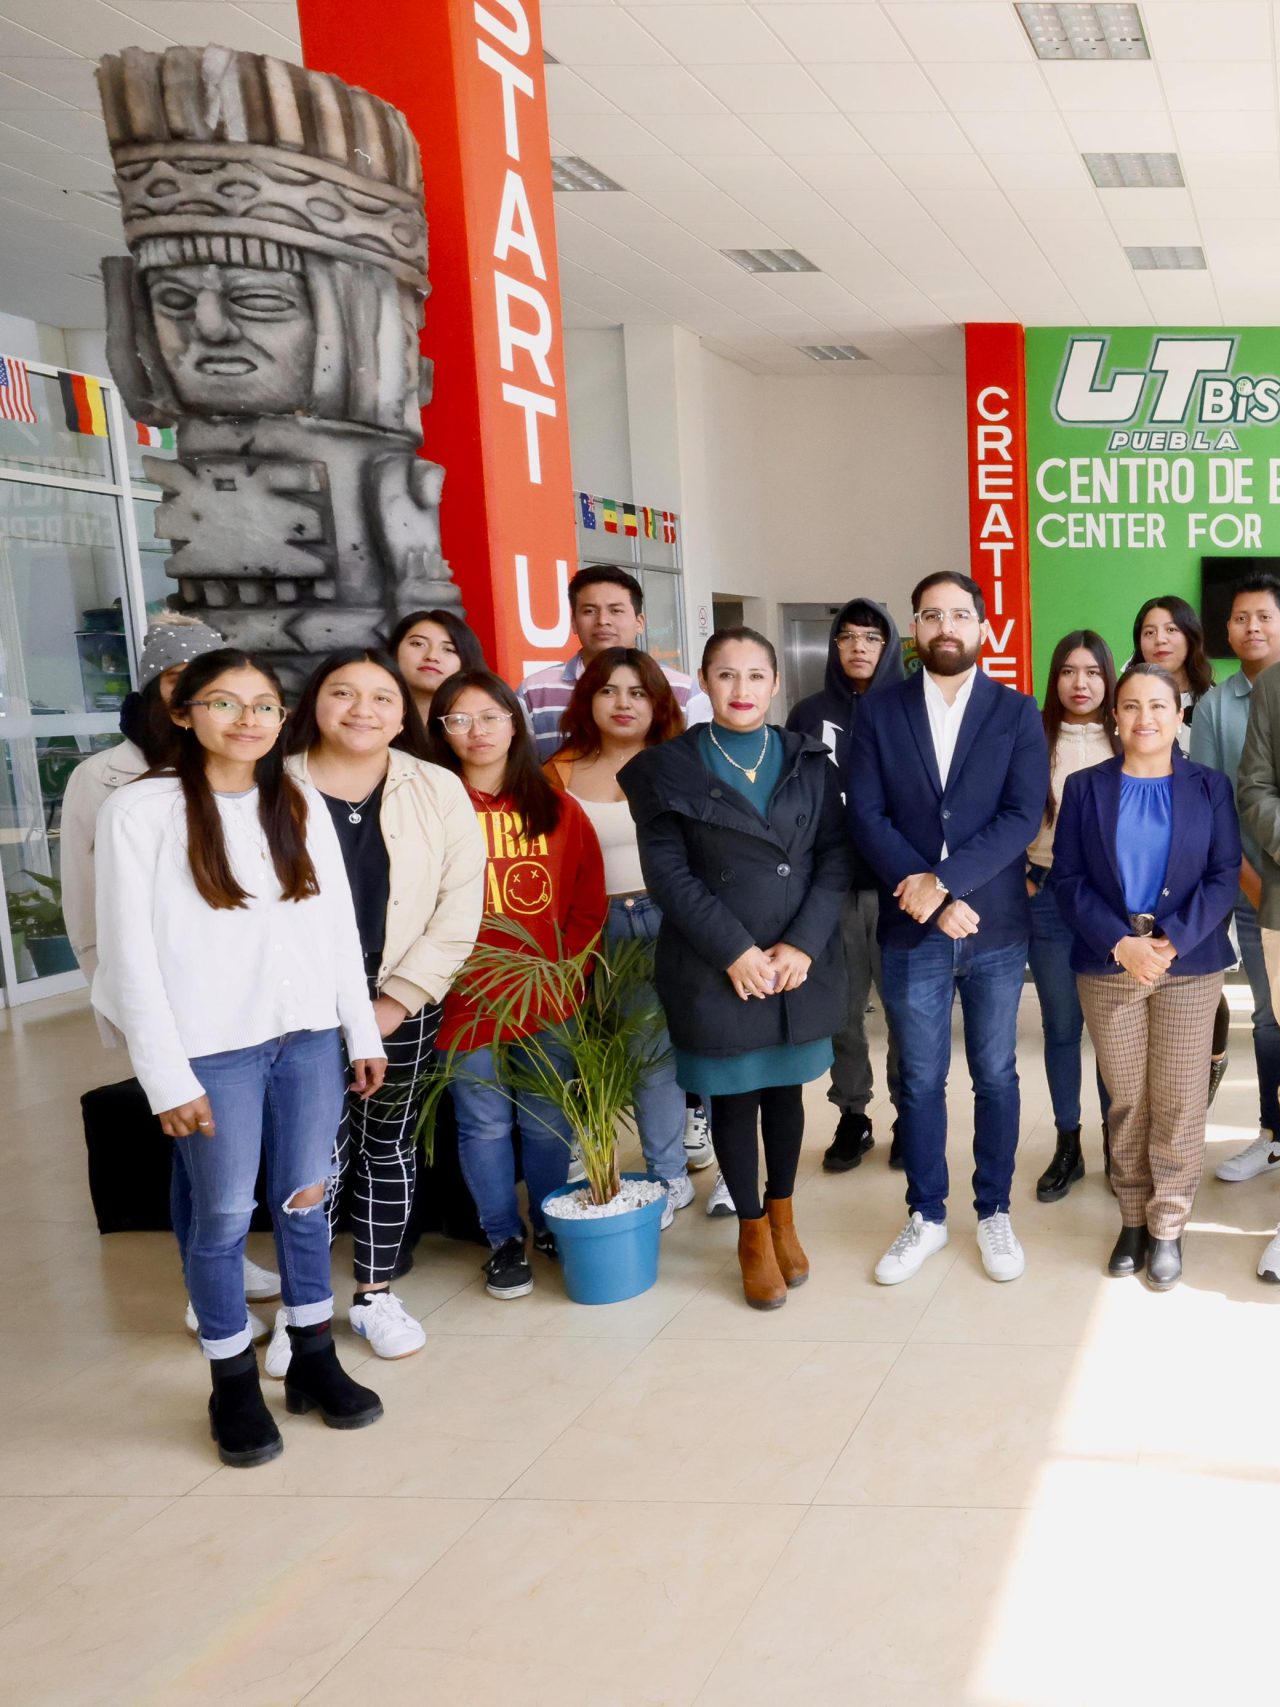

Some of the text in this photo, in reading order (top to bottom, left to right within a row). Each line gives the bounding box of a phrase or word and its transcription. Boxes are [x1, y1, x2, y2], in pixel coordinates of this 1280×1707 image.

[1108, 431, 1239, 451] PUEBLA
[1036, 457, 1195, 504] CENTRO
[1208, 458, 1254, 504] DE
[977, 387, 1016, 691] CREATIVE
[1036, 513, 1167, 548] CENTER
[1188, 513, 1263, 548] FOR
[515, 555, 571, 679] U
